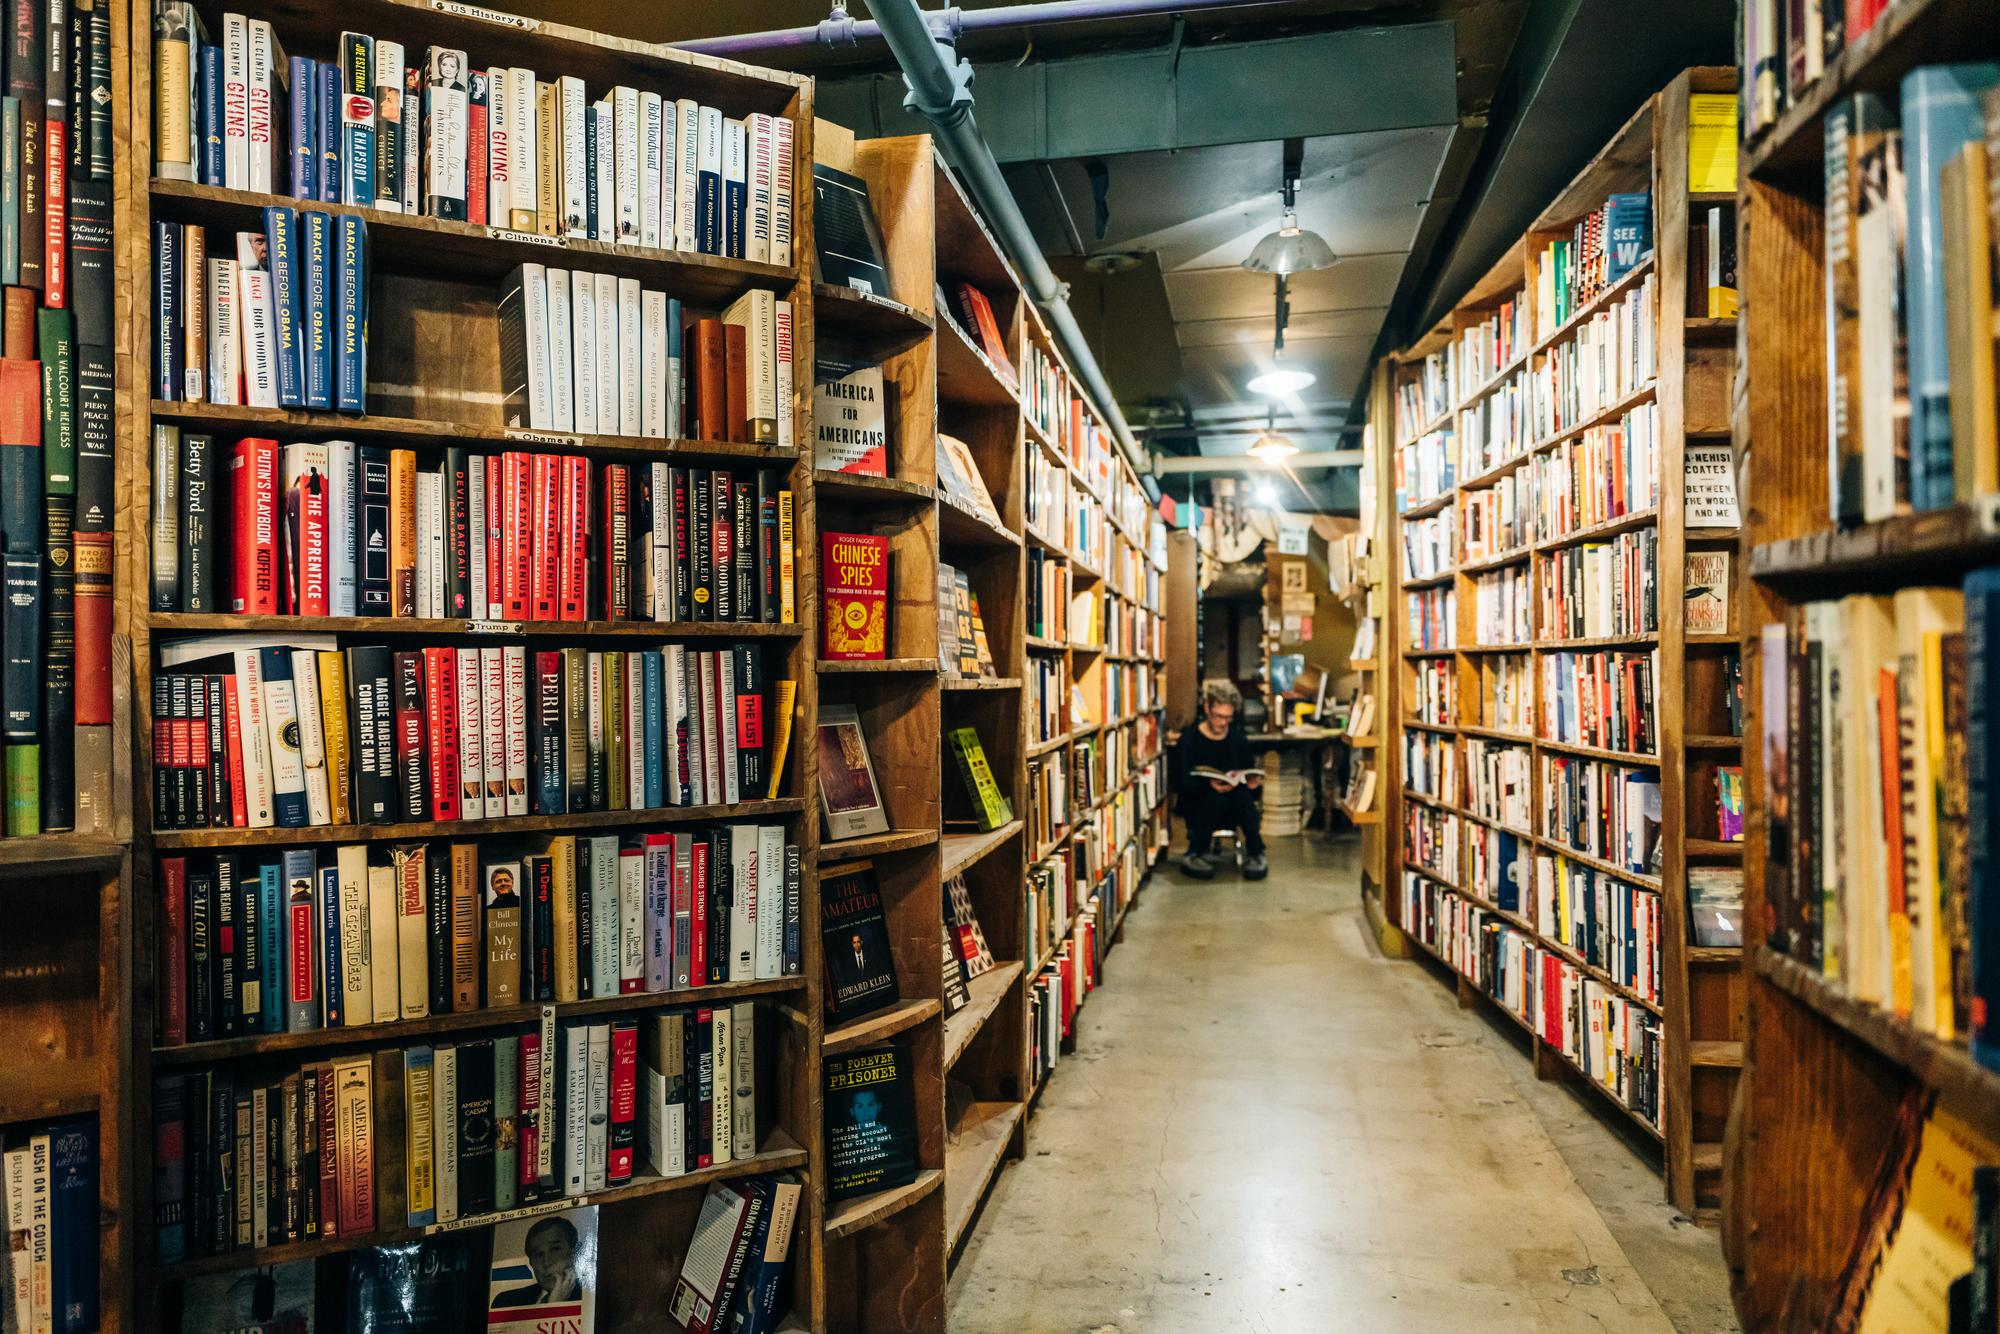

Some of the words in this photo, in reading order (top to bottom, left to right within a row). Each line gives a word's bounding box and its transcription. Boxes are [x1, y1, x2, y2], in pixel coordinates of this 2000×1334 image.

[451, 4, 466, 14] US
[471, 8, 515, 24] History
[230, 21, 240, 39] BILL
[230, 41, 240, 77] CLINTON
[355, 43, 366, 60] JOE
[226, 82, 245, 138] GIVING
[647, 103, 659, 120] Bob
[26, 120, 37, 138] The
[757, 116, 771, 134] BOB
[26, 141, 37, 165] Cove
[353, 131, 367, 183] RHAPSODY
[647, 122, 659, 170] Woodward
[756, 137, 771, 191] WOODWARD
[27, 174, 35, 193] Ron
[27, 194, 35, 213] Rash
[72, 197, 105, 206] BOATNER
[756, 189, 768, 205] THE
[755, 207, 768, 241] CHOICE
[1613, 228, 1636, 241] SEE
[73, 233, 109, 243] Dictionary
[346, 221, 355, 265] BARACK
[505, 232, 553, 245] Clintons
[162, 234, 172, 310] STONEWALLED
[251, 276, 262, 301] RAGE
[346, 267, 355, 311] BEFORE
[253, 308, 264, 328] BOB
[346, 314, 355, 354] OBAMA
[777, 313, 792, 364] OVERHAUL
[58, 341, 67, 356] THE
[254, 330, 268, 389] WOODWARD
[58, 360, 69, 408] VALCOURT
[825, 381, 875, 402] AMERICA
[83, 412, 109, 420] PEACE
[84, 402, 108, 410] FIERY
[843, 408, 858, 421] FOR
[60, 410, 70, 448] HEIRESS
[84, 432, 108, 440] COLD
[522, 433, 564, 445] Obama
[819, 425, 883, 446] AMERICANS
[86, 441, 105, 450] WAR
[185, 440, 205, 477] Betty
[257, 448, 271, 489] PUTIN'S
[519, 460, 527, 468] A
[1685, 465, 1726, 474] COATES
[189, 481, 205, 512] Ford
[456, 471, 464, 519] DEVIL'S
[519, 475, 527, 500] VERY
[614, 468, 626, 513] RUSSIAN
[699, 479, 707, 518] TRUMP
[1686, 485, 1730, 493] BETWEEN
[308, 494, 322, 516] THE
[676, 488, 684, 515] BEST
[1685, 497, 1701, 505] THE
[1695, 509, 1713, 517] AND
[1716, 509, 1729, 517] ME
[257, 492, 271, 545] PLAYBOOK
[519, 508, 527, 550] STABLE
[457, 523, 466, 579] BARGAIN
[614, 515, 626, 564] ROULETTE
[677, 518, 686, 560] PEOPLE
[308, 521, 322, 599] APPRENTICE
[700, 523, 709, 583] REVEALED
[832, 543, 881, 566] CHINESE
[256, 549, 271, 591] KOFFLER
[519, 556, 527, 599] GENIUS
[840, 566, 873, 587] SPIES
[475, 623, 509, 632] Trump
[404, 659, 416, 696] FEAR
[512, 657, 523, 690] FIRE
[191, 678, 204, 717] COLLUSION
[376, 677, 389, 718] MAGGIE
[542, 673, 559, 727] PERIL
[744, 697, 755, 718] THE
[359, 684, 374, 746] CONFIDENCE
[512, 695, 524, 729] AND
[406, 719, 418, 744] BOB
[744, 721, 755, 745] LIST
[362, 750, 375, 772] MAN
[377, 720, 392, 777] HABERMAN
[512, 733, 525, 766] FURY
[407, 748, 422, 816] WOODWARD
[220, 862, 231, 892] KILLING
[539, 863, 550, 874] In
[787, 851, 798, 880] JOE
[327, 876, 335, 904] Kamala
[345, 881, 358, 912] THE
[538, 876, 550, 902] Deep
[833, 880, 861, 898] THE
[220, 893, 232, 922] REAGAN
[498, 911, 510, 919] Bill
[788, 882, 798, 923] BIDEN
[821, 893, 880, 920] AMATEUR
[488, 920, 518, 929] Clinton
[346, 915, 361, 992] GRANDEES
[494, 935, 513, 948] My
[491, 951, 517, 962] Life
[838, 979, 868, 999] EDWARD
[869, 974, 890, 991] KLEIN
[545, 1021, 554, 1065] Memoir
[578, 1040, 586, 1063] THE
[848, 1053, 894, 1068] FOREVER
[830, 1067, 896, 1087] PRISONER
[461, 1099, 492, 1109] AMERICAN
[543, 1083, 551, 1103] Bio
[464, 1107, 488, 1116] CAESAR
[578, 1113, 585, 1132] WE
[541, 1108, 552, 1148] History
[34, 1144, 45, 1172] BUSH
[577, 1135, 585, 1166] HOLD
[34, 1177, 45, 1193] ON
[34, 1197, 45, 1219] THE
[447, 1221, 460, 1230] US
[463, 1216, 497, 1227] History
[500, 1211, 515, 1219] Bio
[531, 1203, 565, 1213] Memoir
[741, 1198, 762, 1238] OBAMA'S
[34, 1224, 45, 1263] COUCH
[727, 1239, 751, 1281] AMERICA
